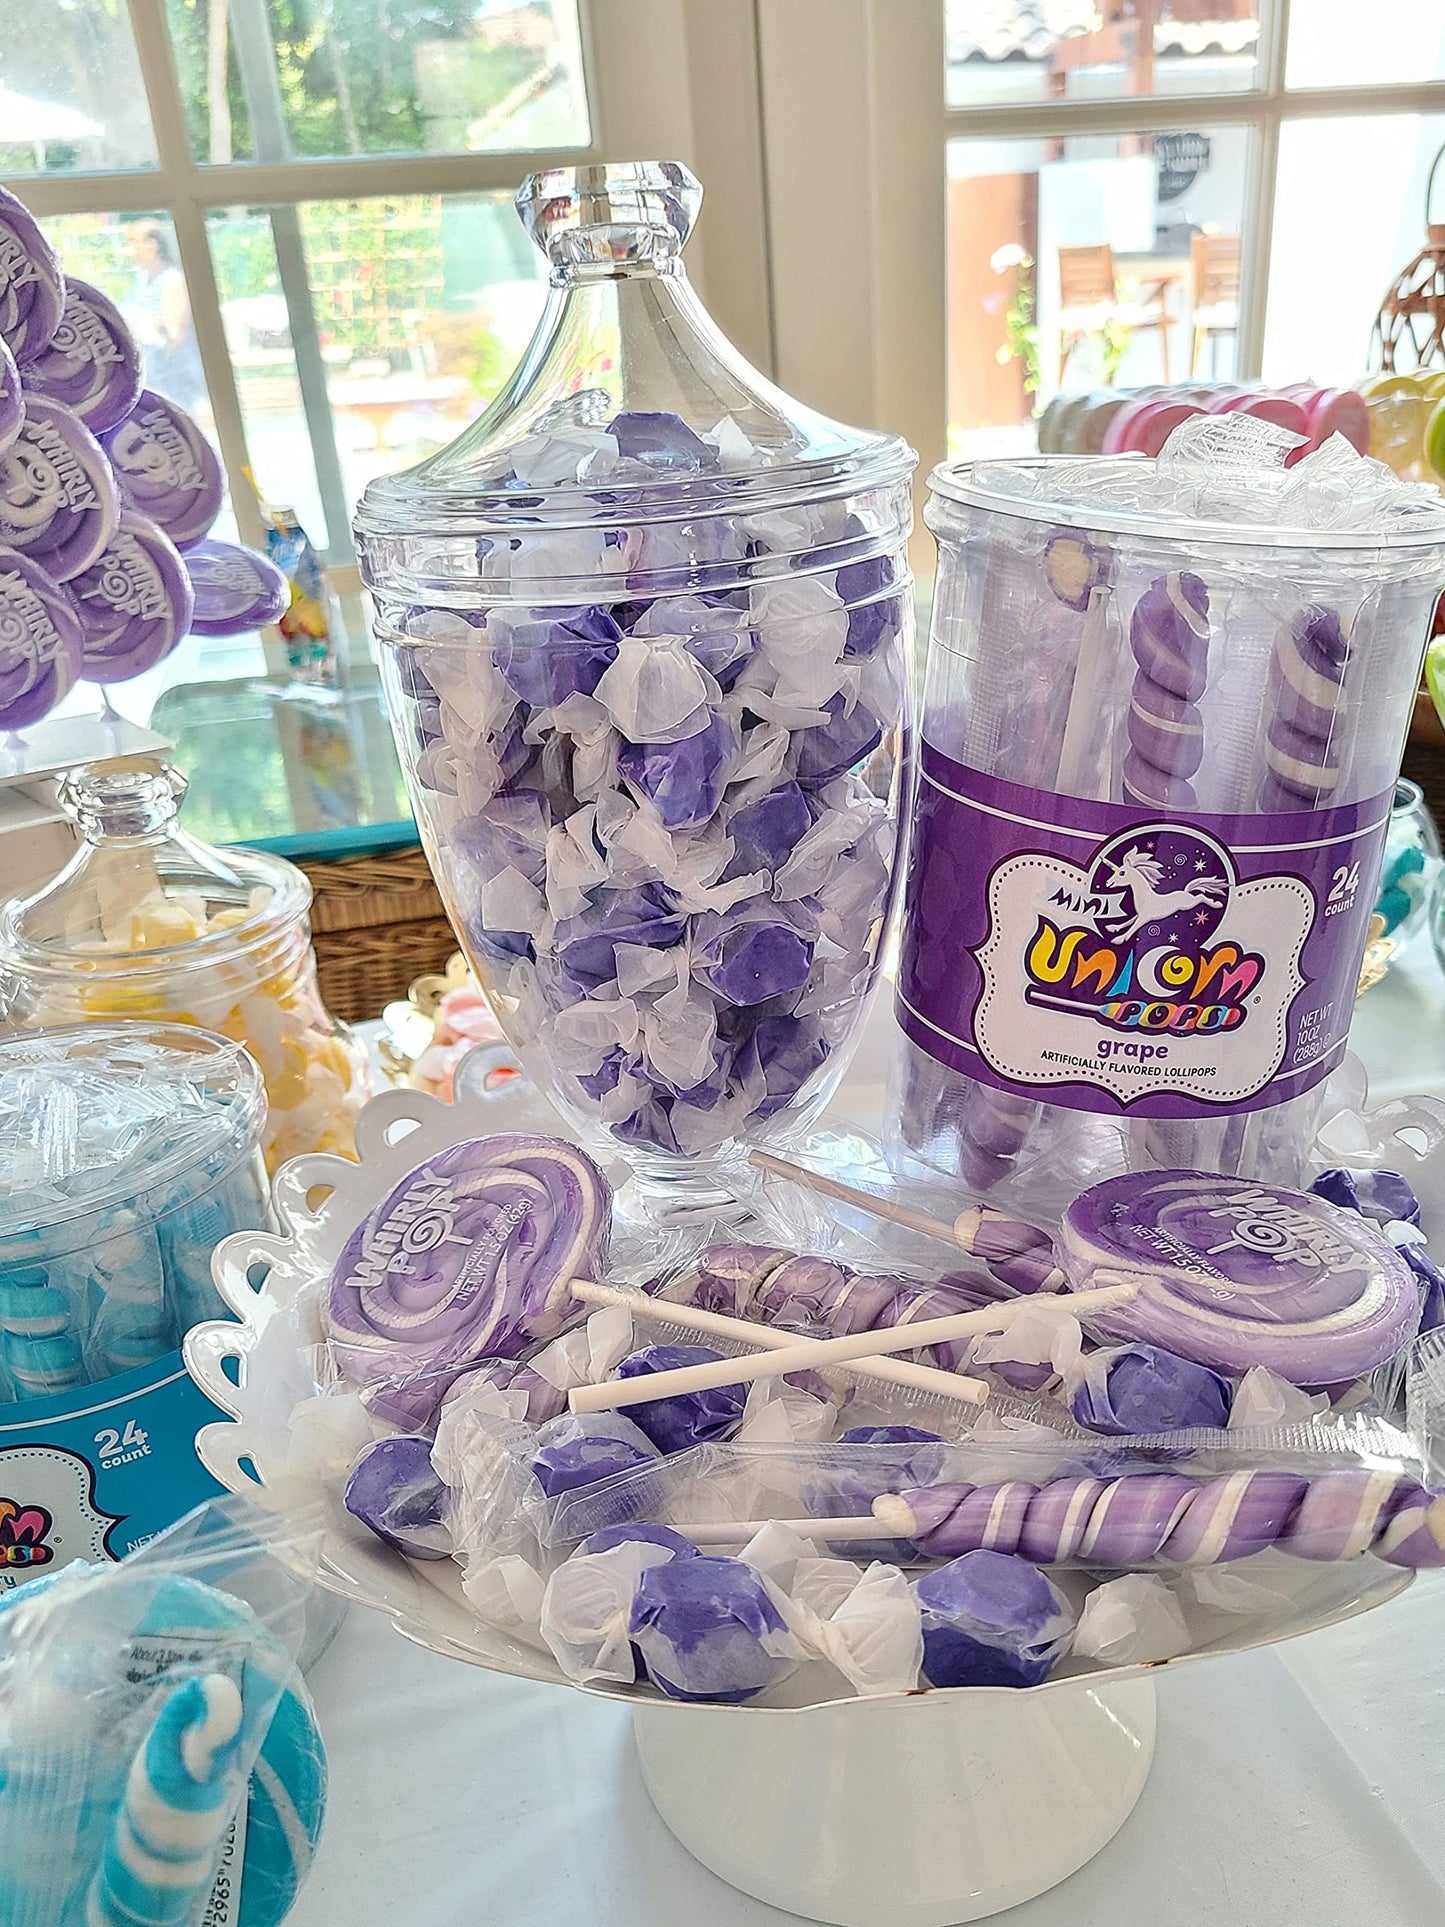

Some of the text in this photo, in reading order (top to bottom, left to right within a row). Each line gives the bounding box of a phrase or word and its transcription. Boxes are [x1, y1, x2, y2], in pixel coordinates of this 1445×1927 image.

[27, 420, 102, 513] WHIRLY
[142, 408, 209, 491] WHIRLY
[95, 555, 143, 607] POP
[107, 534, 173, 621] WHIRLY
[1327, 861, 1360, 902] 24
[1325, 895, 1355, 917] count
[1117, 1000, 1225, 1030] POPS
[1300, 1001, 1334, 1029] NET WT
[1040, 1049, 1217, 1077] ARTIFICIALLY FLAVORED LOLLIPOPS
[1097, 1039, 1169, 1062] grape
[344, 1167, 453, 1287] WHIRLY
[387, 1190, 466, 1275] POP
[1129, 1224, 1156, 1240] NET
[1151, 1239, 1178, 1254] WT
[1152, 1226, 1201, 1261] ARTIFICIALLY
[1208, 1206, 1321, 1267] POP
[1226, 1189, 1382, 1273] WHIRLY
[452, 1240, 487, 1288] ARTIFICIALLY
[456, 1277, 476, 1301] NET
[471, 1257, 490, 1278] WT
[495, 1226, 514, 1242] OZ
[505, 1198, 533, 1225] (42g)
[94, 1420, 148, 1458] 24
[101, 1444, 152, 1469] count
